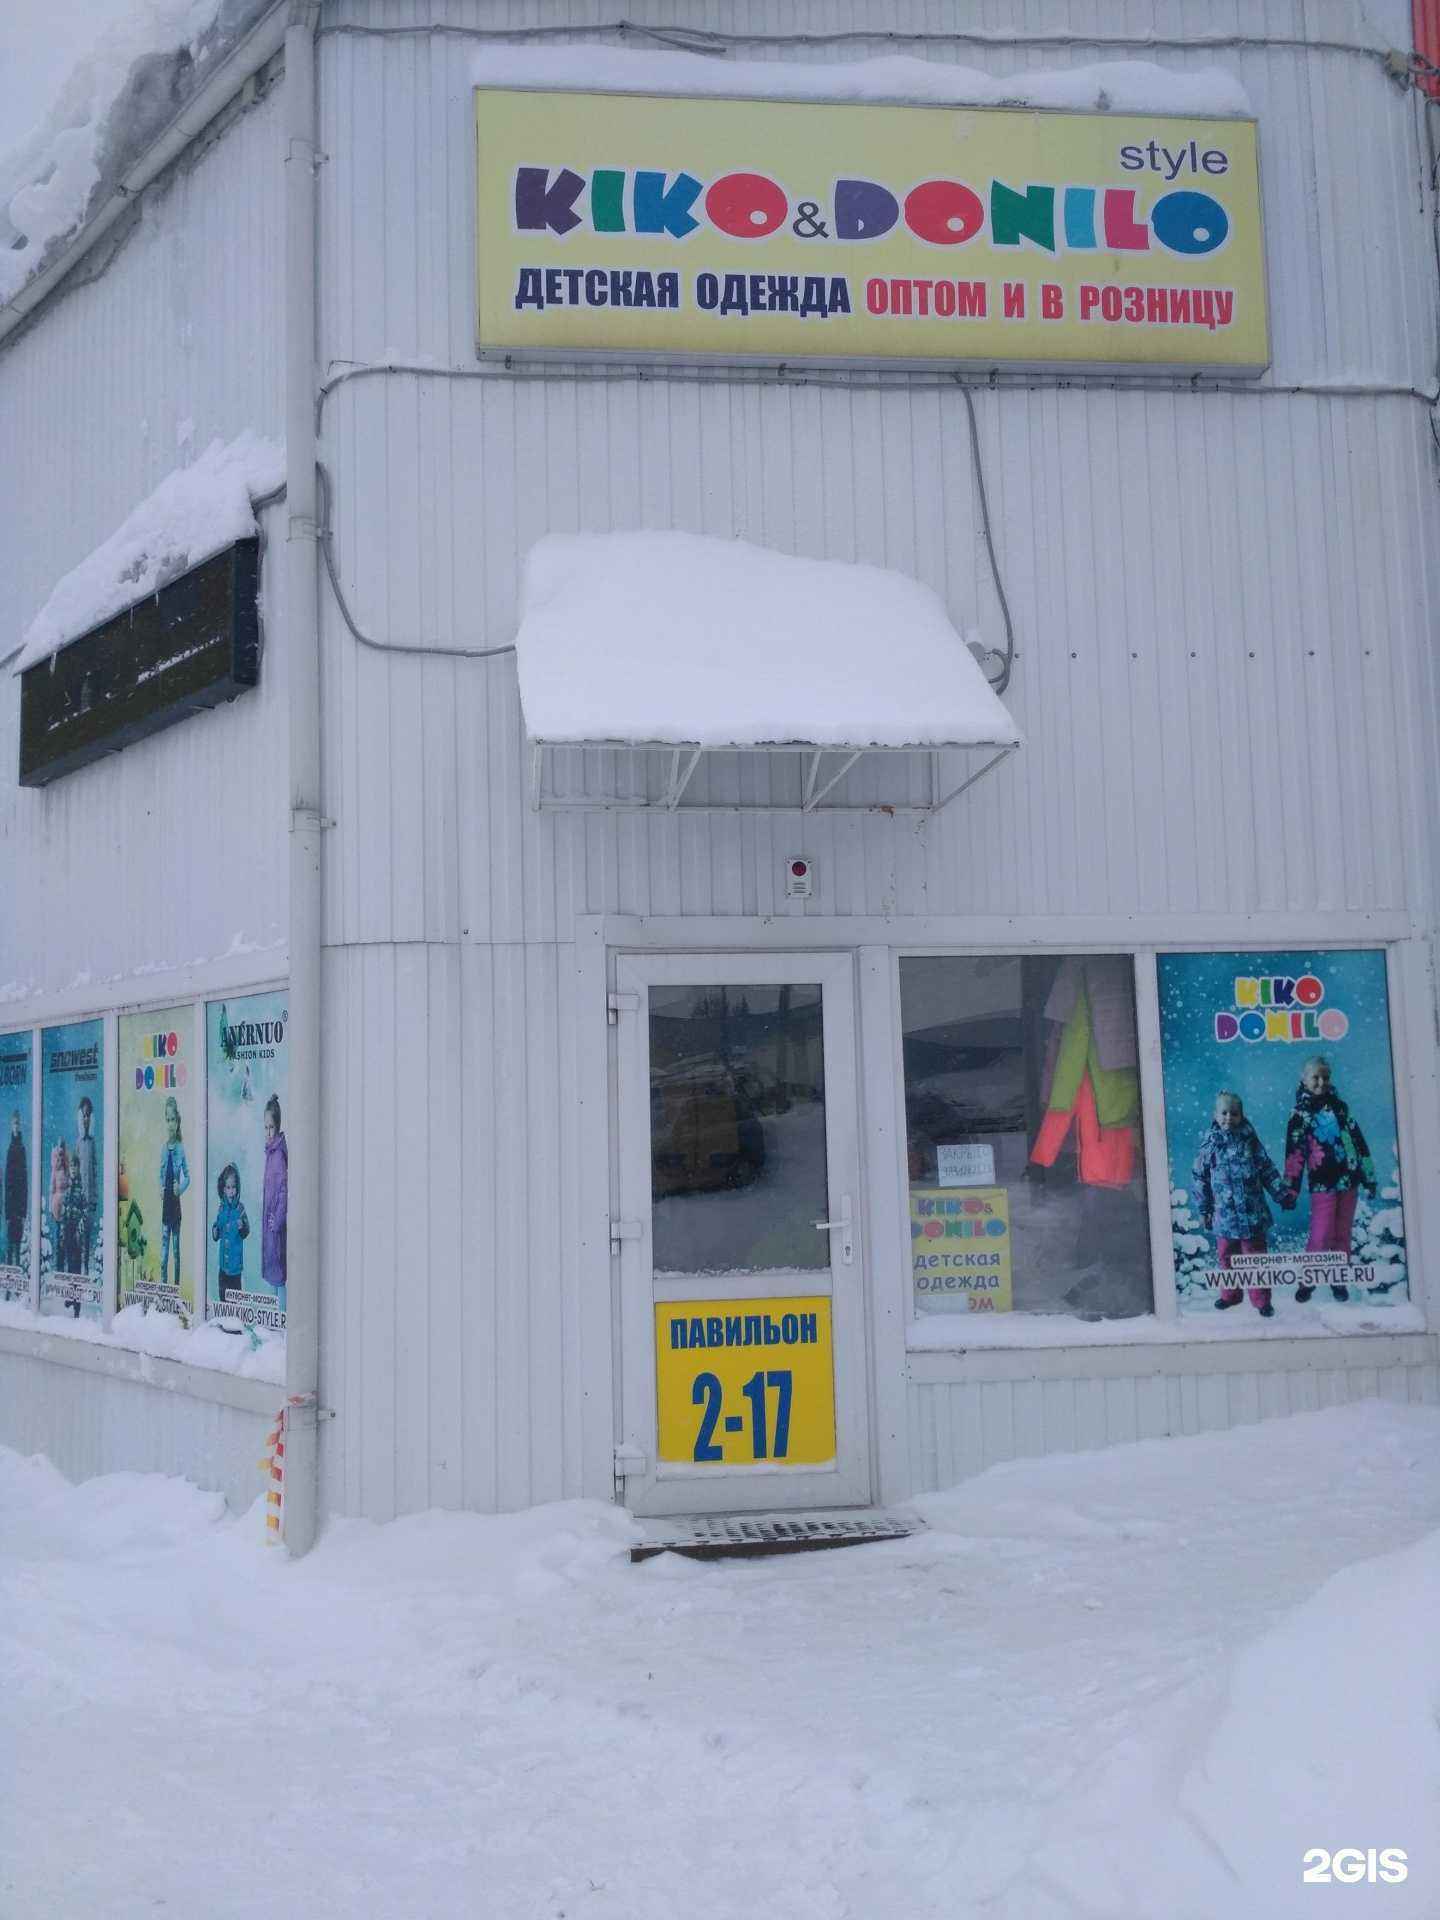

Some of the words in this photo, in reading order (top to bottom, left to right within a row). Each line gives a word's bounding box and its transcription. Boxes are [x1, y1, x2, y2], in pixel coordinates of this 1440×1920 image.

[1120, 140, 1228, 181] style
[515, 268, 680, 311] ДЕТСКАЯ
[696, 272, 851, 318] ОДЕЖДА
[866, 278, 987, 317] ОПТОМ
[1003, 283, 1025, 318] И
[1042, 284, 1064, 320] В
[1080, 286, 1234, 330] РОЗНИЦУ
[1235, 975, 1325, 1009] KIKO
[1215, 1008, 1349, 1043] DONILO
[914, 1251, 1001, 1270] детская
[1205, 1266, 1376, 1289] WWW.KIKO-STYLE.RU
[916, 1274, 1000, 1292] одежда
[670, 1313, 817, 1350] ПАВИЛЬОН
[692, 1370, 792, 1463] 2-17
